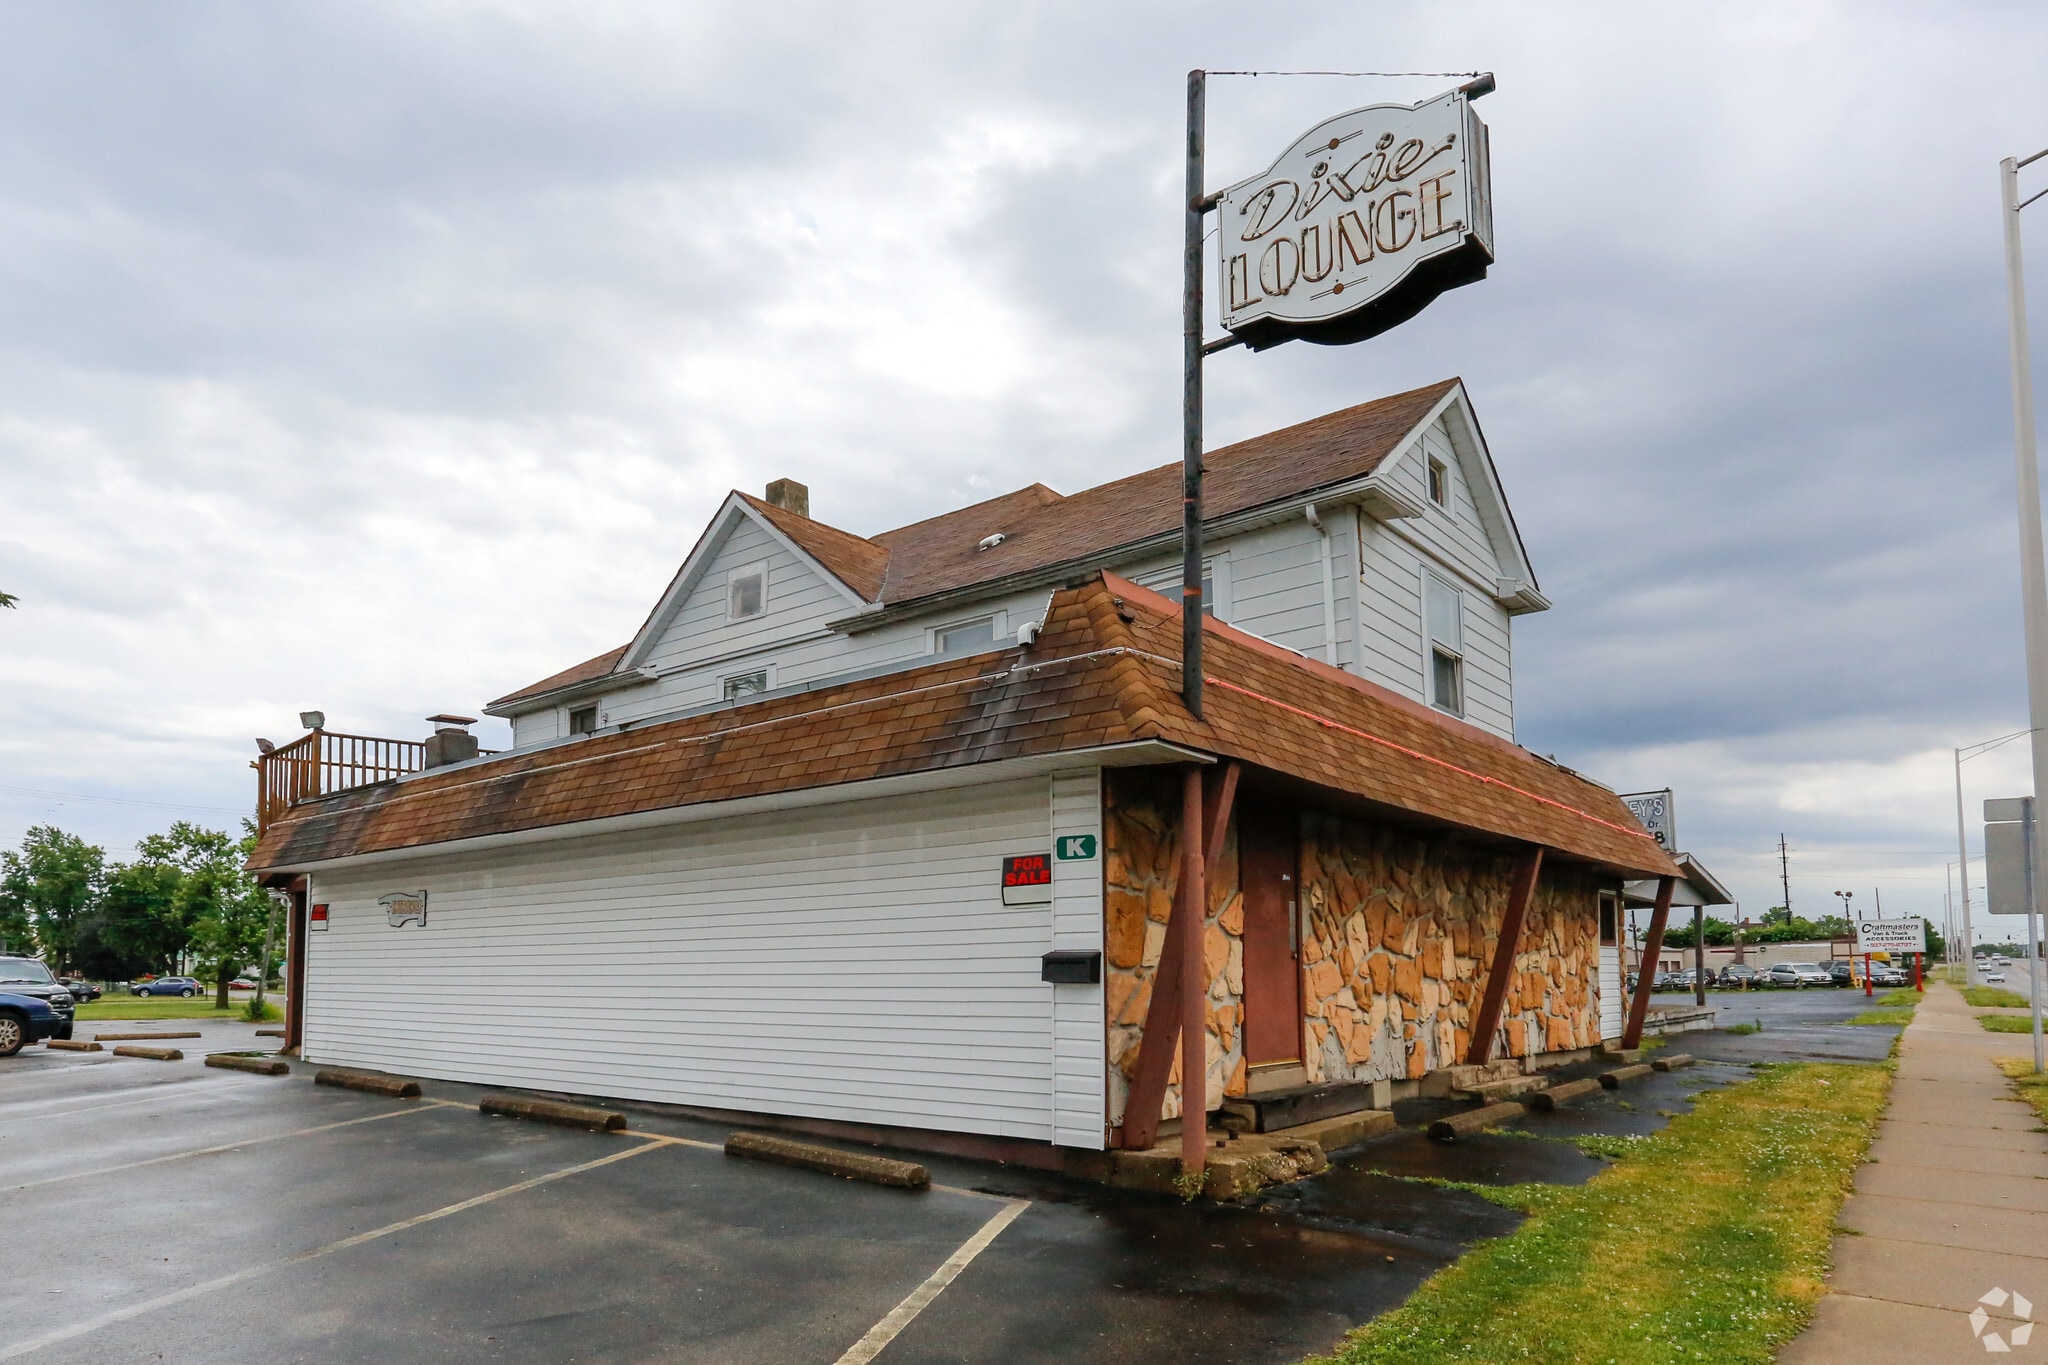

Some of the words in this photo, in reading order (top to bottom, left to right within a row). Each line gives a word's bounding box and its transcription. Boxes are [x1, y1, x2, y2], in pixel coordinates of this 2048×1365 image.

[1240, 132, 1456, 241] Dixie
[1230, 169, 1462, 311] LOUNGE
[1648, 820, 1662, 829] Dr.
[1066, 837, 1087, 857] K
[1013, 856, 1043, 871] FOR
[1005, 870, 1051, 886] SALE
[1861, 923, 1919, 934] Craftmasters
